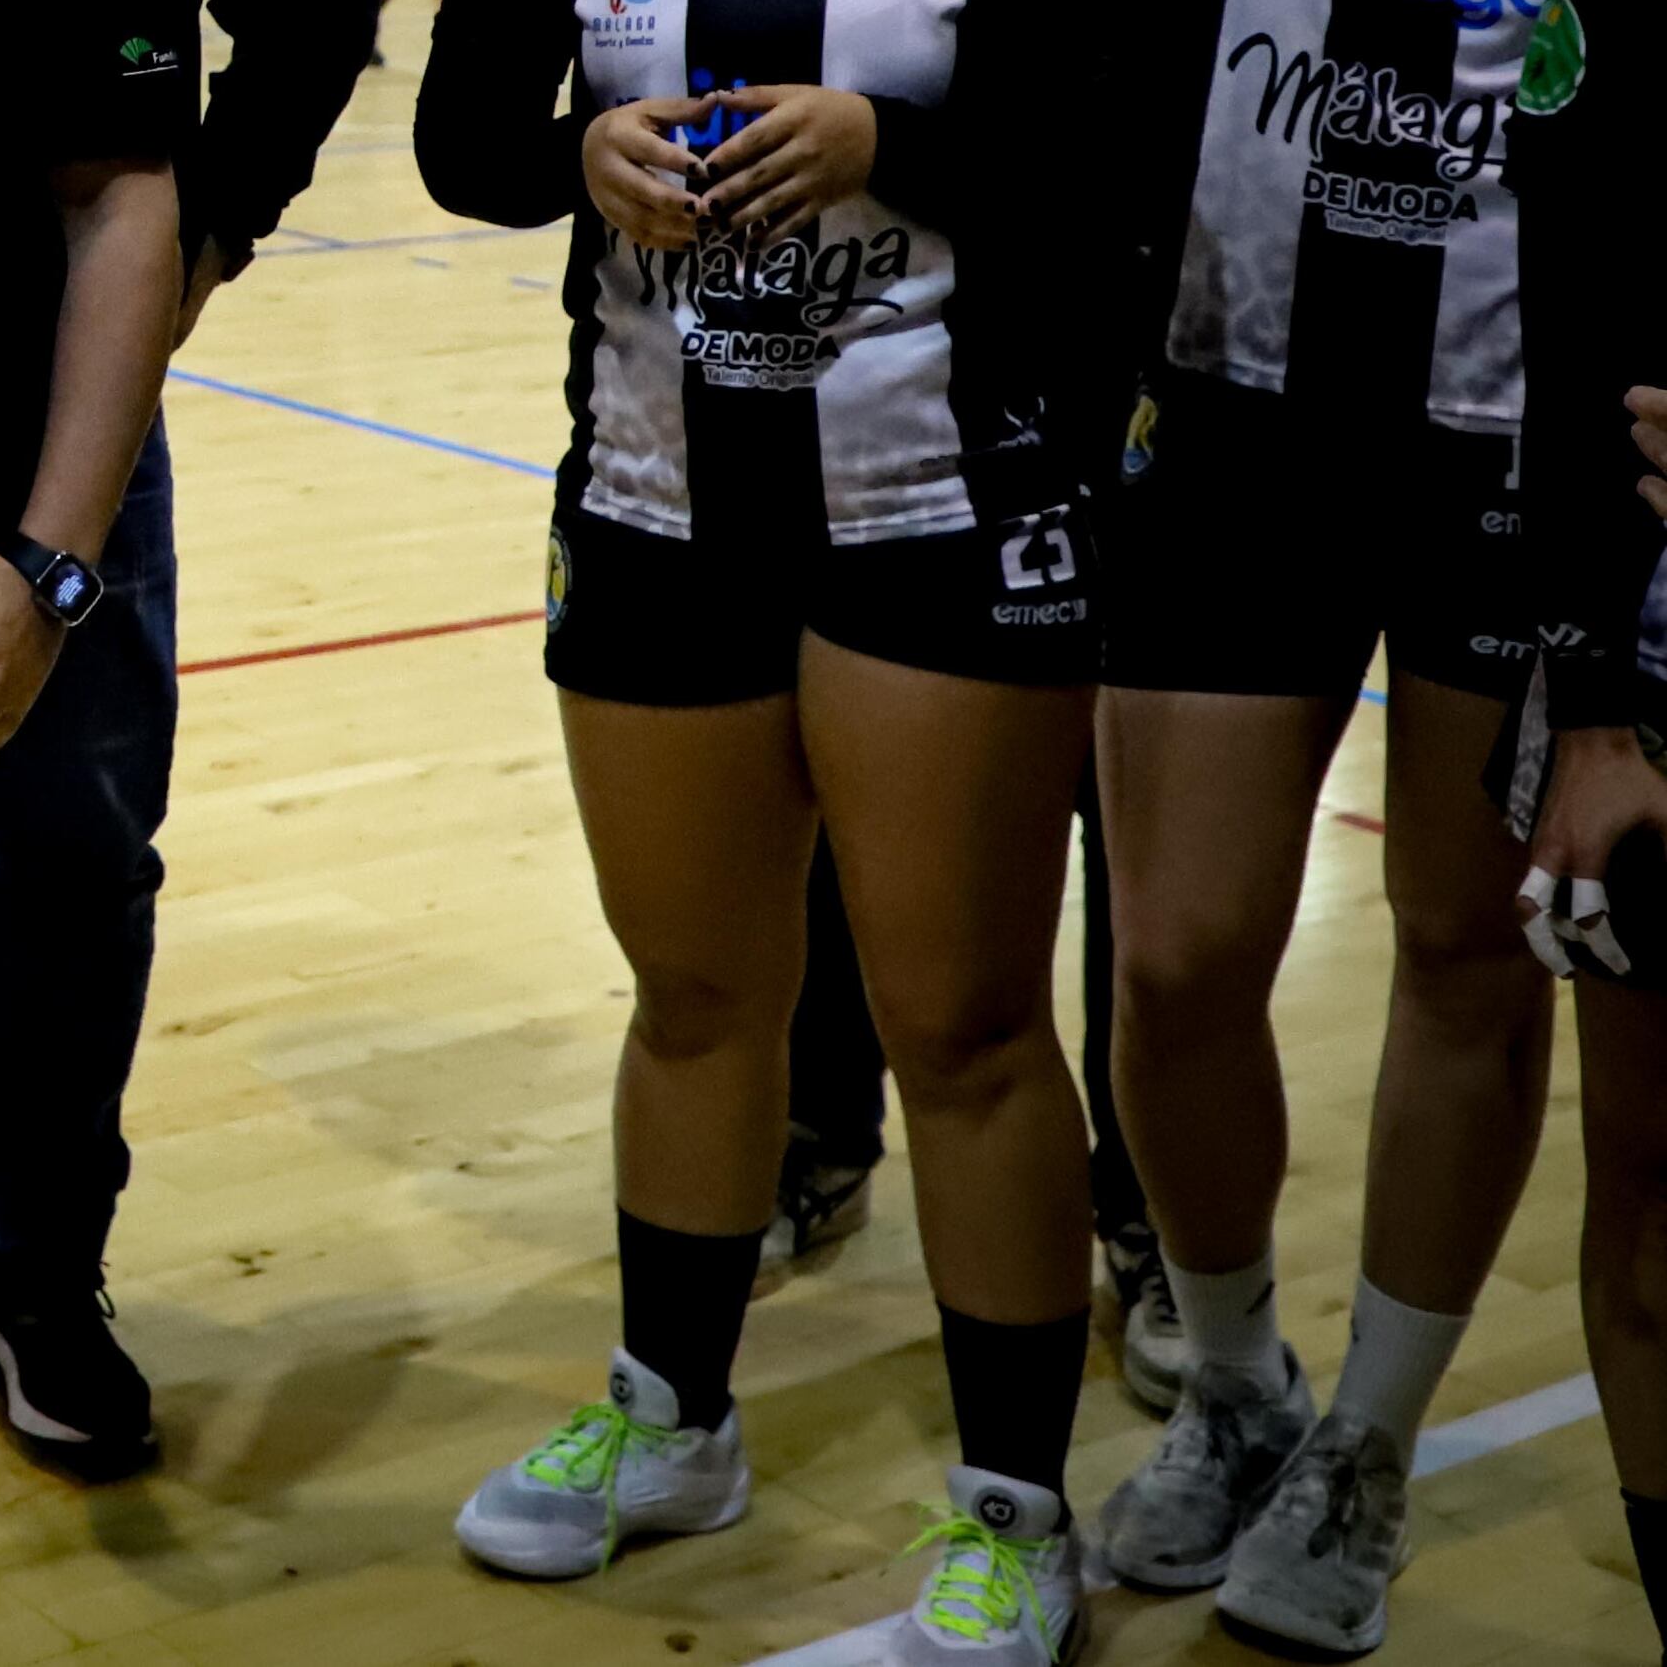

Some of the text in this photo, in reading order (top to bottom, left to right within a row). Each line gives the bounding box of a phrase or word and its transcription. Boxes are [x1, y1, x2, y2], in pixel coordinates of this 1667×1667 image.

[1228, 32, 1507, 183] Málag
[1304, 172, 1478, 221] DE MODA
[680, 333, 841, 361] DE MODA
[990, 601, 1071, 625] emec
